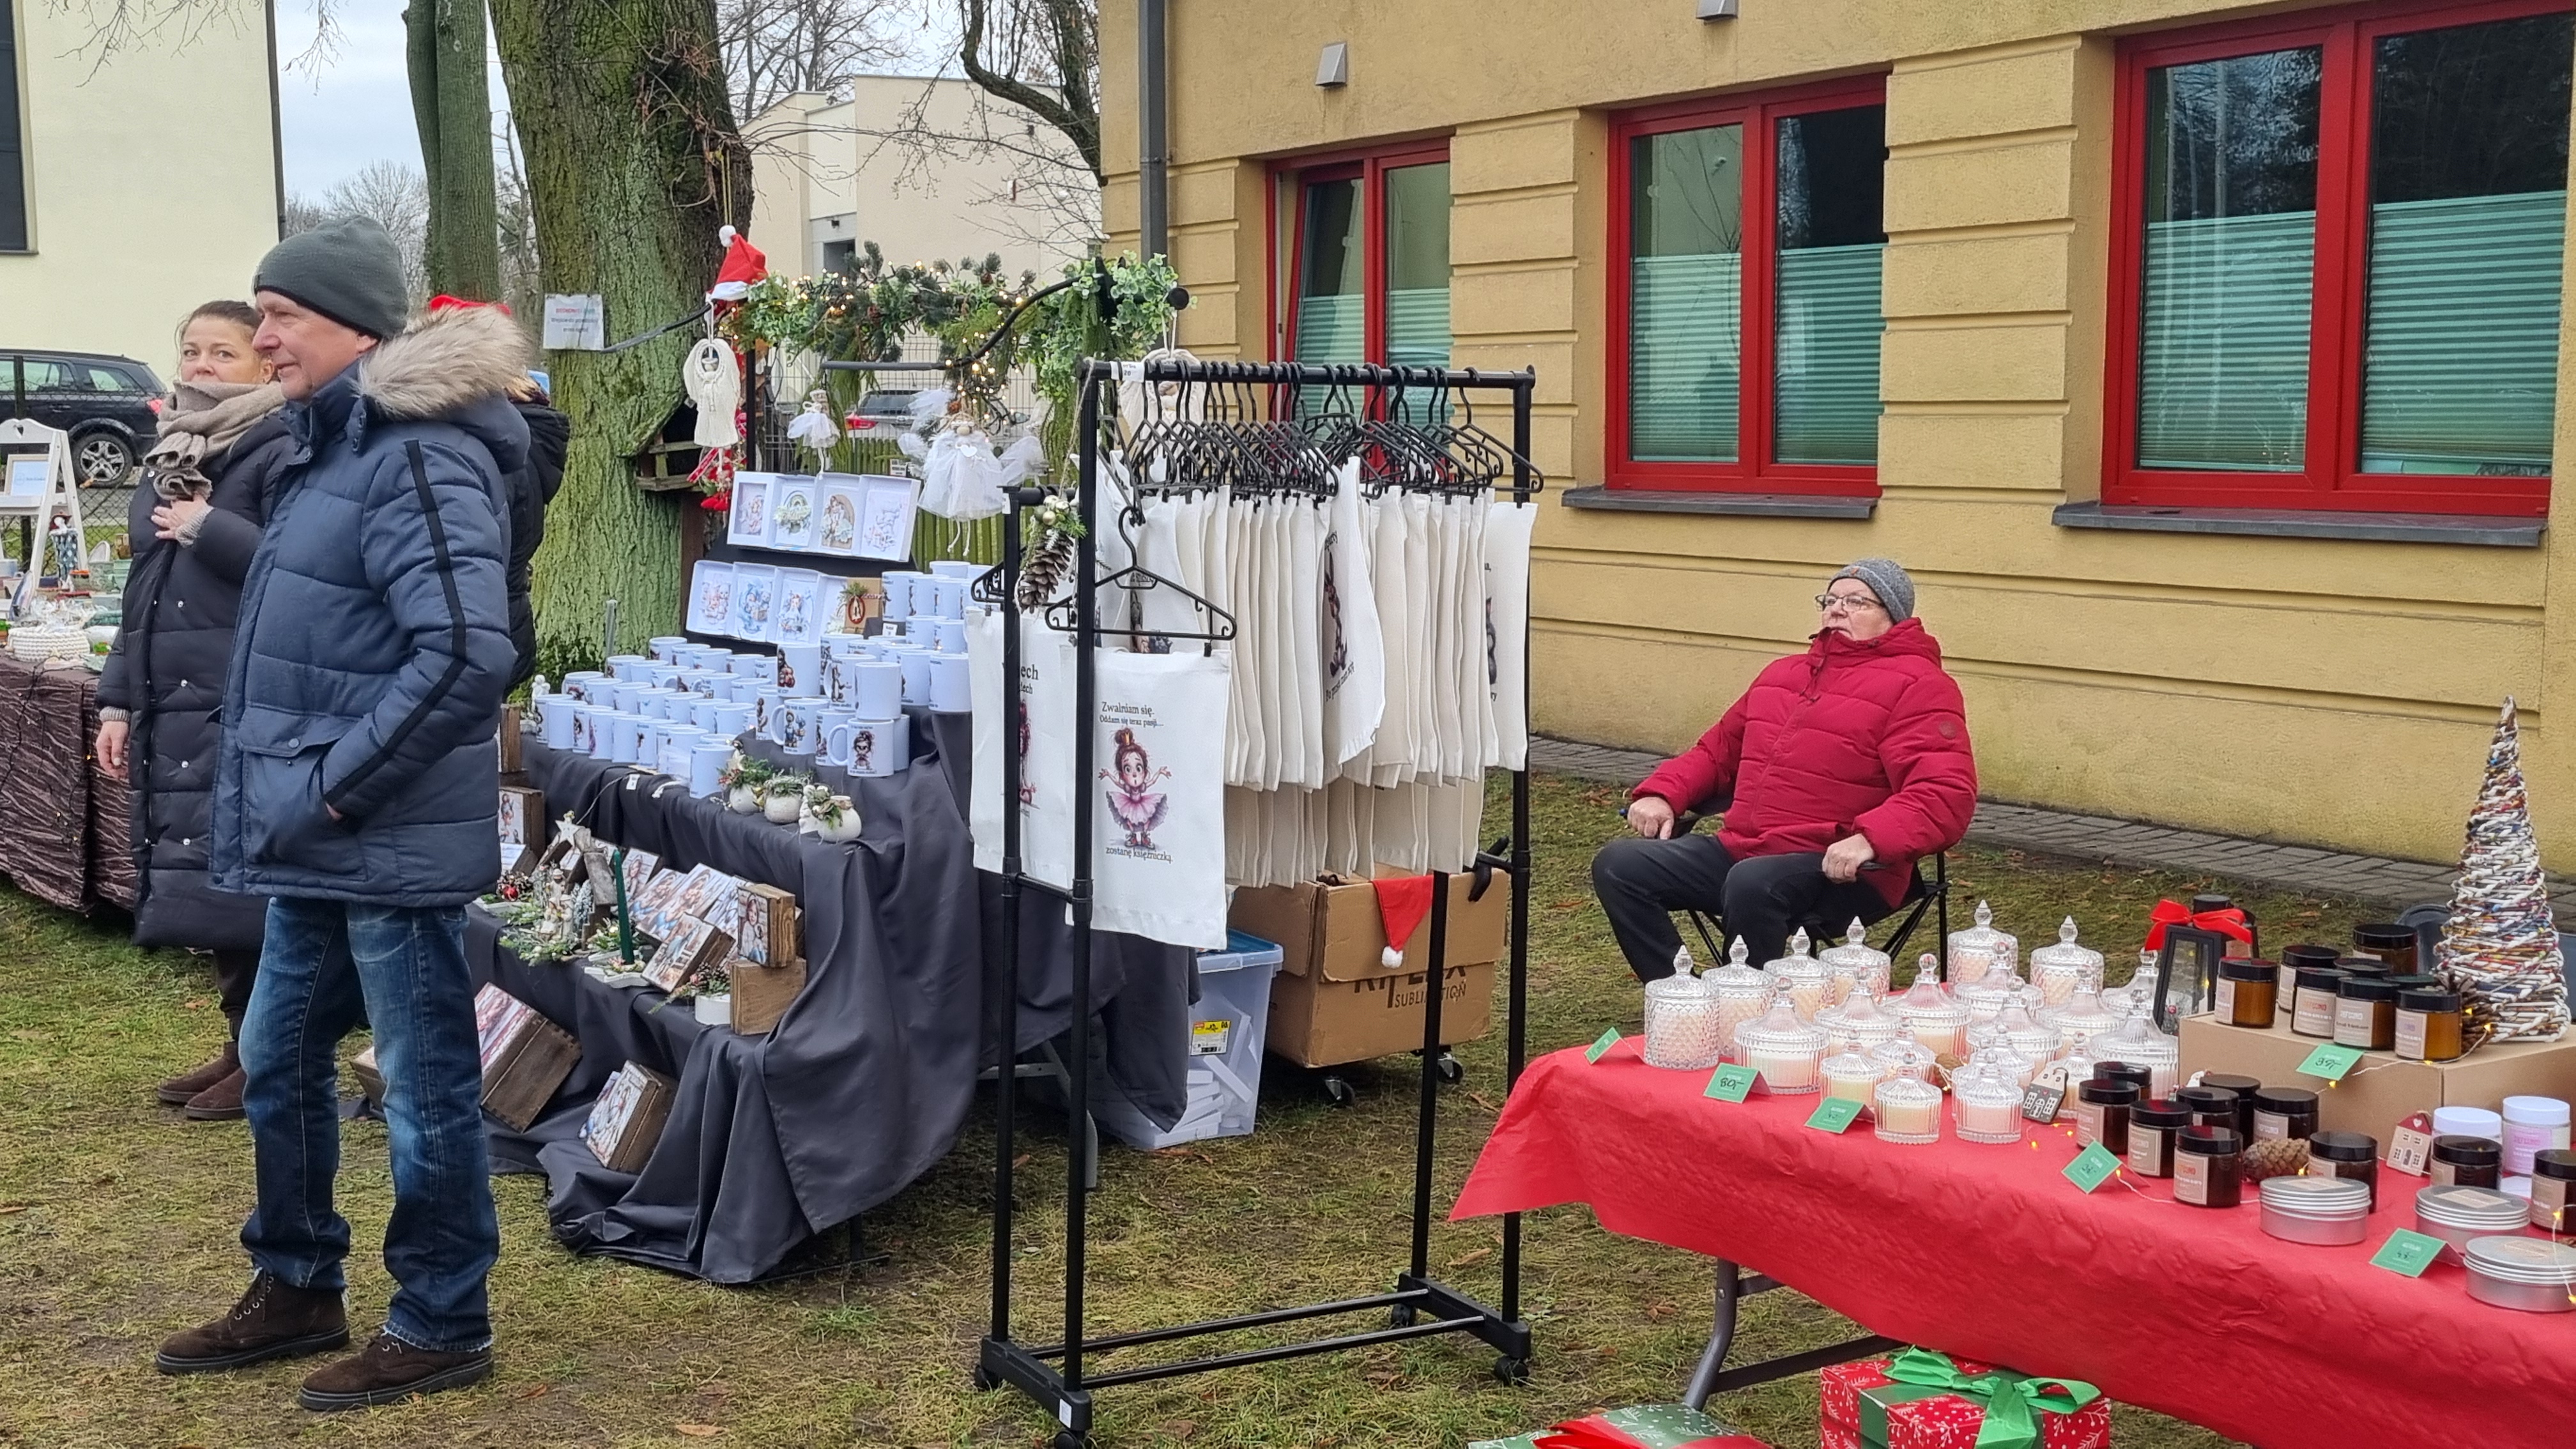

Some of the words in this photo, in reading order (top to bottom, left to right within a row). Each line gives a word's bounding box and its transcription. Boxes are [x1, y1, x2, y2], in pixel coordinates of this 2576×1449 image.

[1102, 702, 1139, 714] Zwalniam
[1100, 715, 1120, 724] Oddam
[1106, 847, 1131, 859] zostanę
[1395, 983, 1467, 1008] SUBLIION
